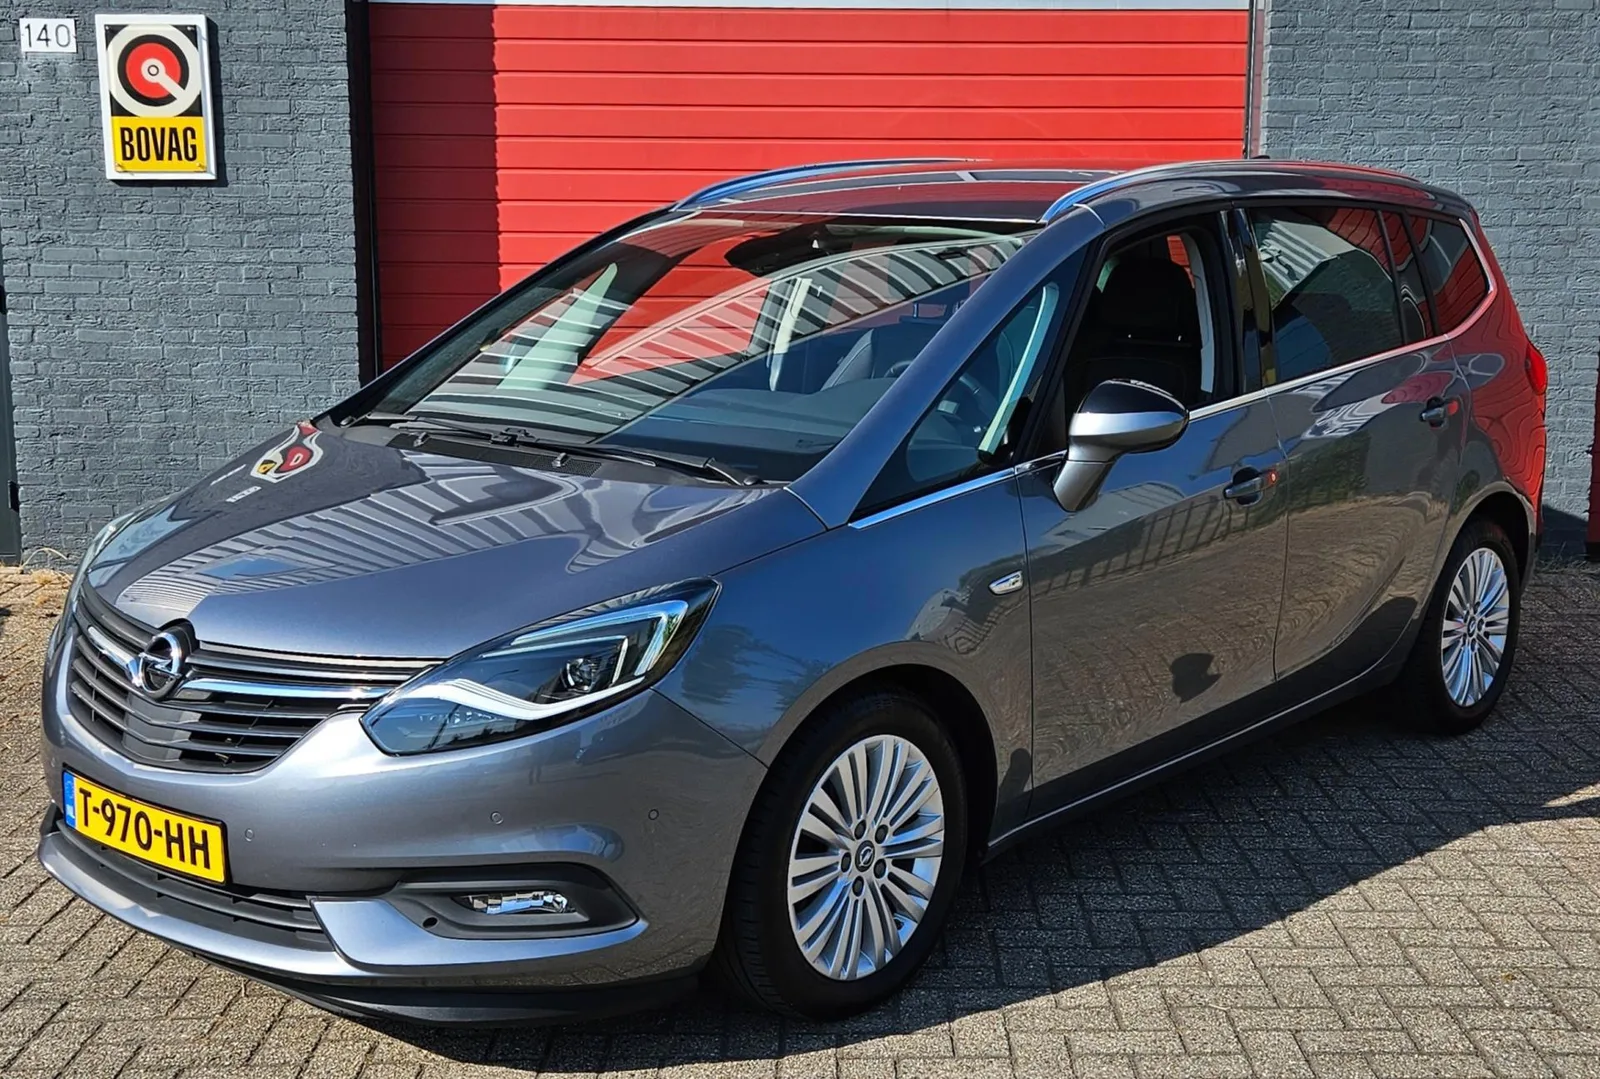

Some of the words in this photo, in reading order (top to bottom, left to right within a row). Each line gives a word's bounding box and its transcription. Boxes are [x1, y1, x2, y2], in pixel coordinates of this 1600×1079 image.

[24, 24, 71, 48] 140
[119, 126, 198, 162] BOVAG
[78, 787, 211, 870] T-970-HH
